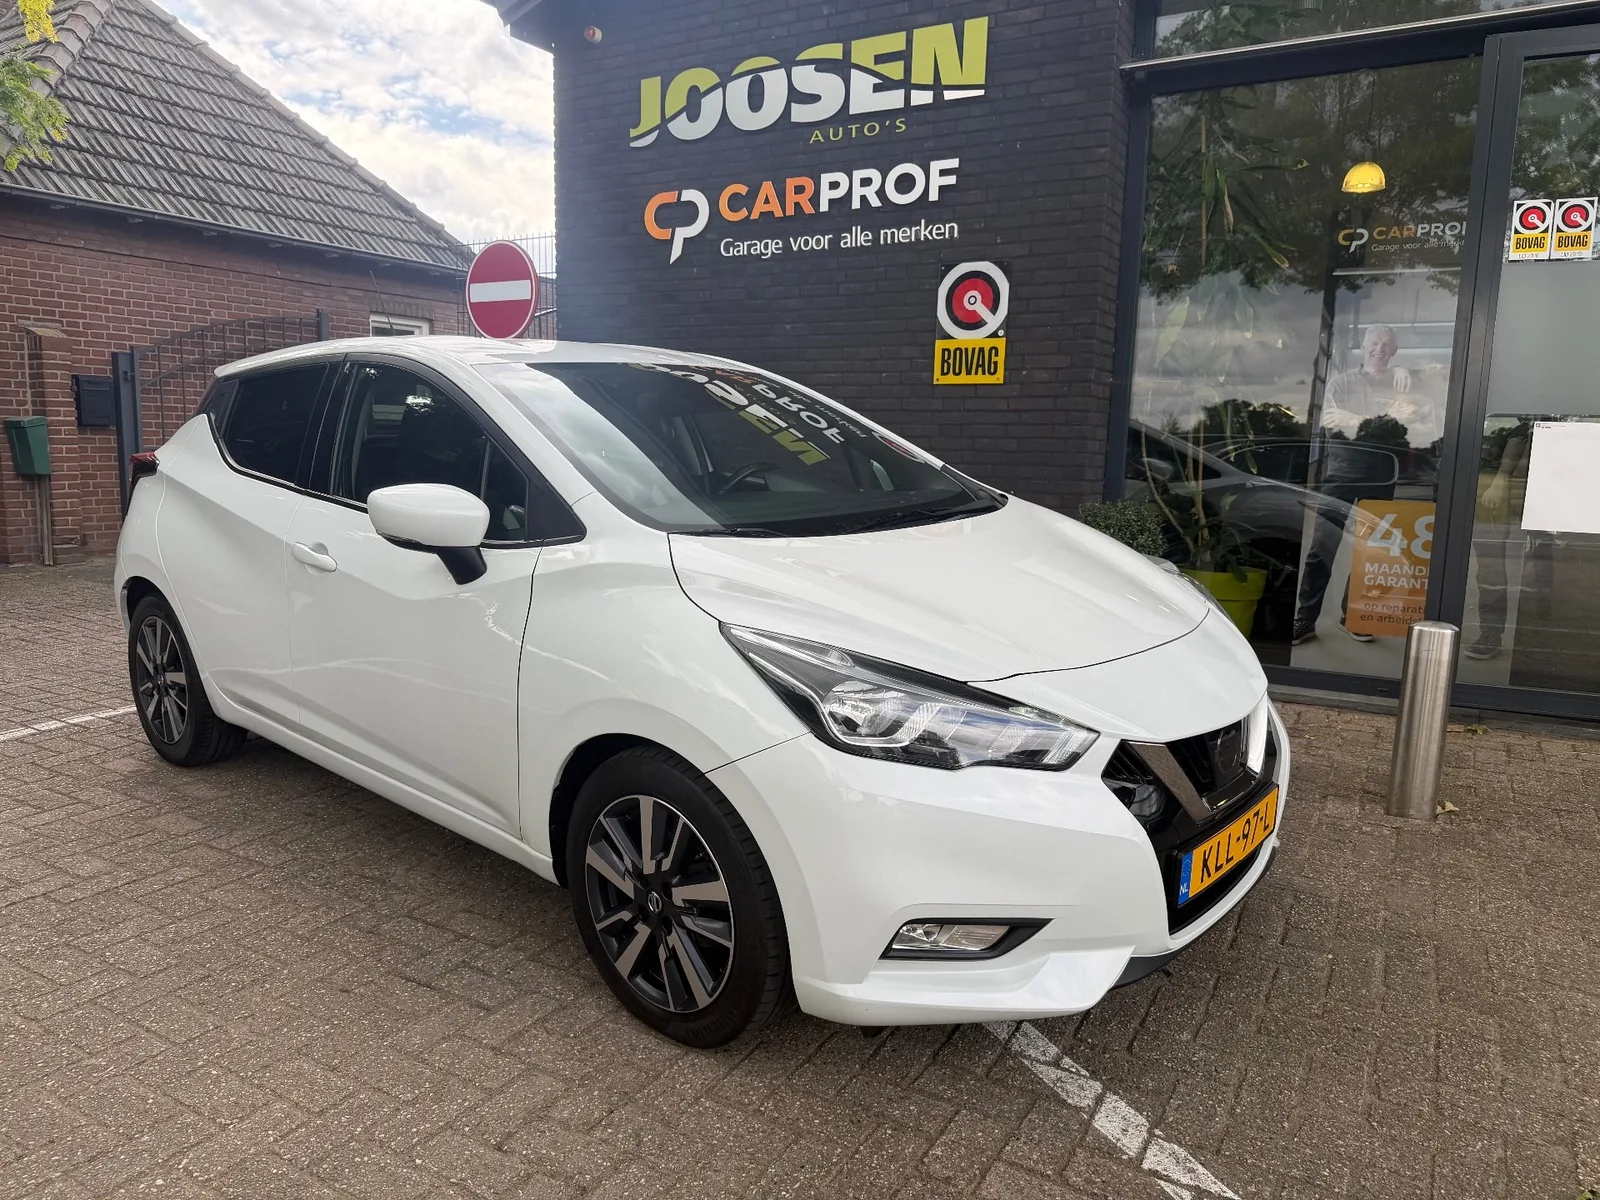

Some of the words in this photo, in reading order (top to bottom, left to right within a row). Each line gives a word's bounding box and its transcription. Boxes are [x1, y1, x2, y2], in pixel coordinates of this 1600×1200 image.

[629, 16, 989, 147] JOOSEN
[809, 118, 907, 144] AUTO'S
[718, 158, 960, 222] CARPROF
[720, 237, 783, 259] Garage
[790, 231, 833, 251] voor
[840, 226, 872, 248] alle
[880, 220, 959, 245] merken
[1515, 236, 1546, 250] BOVAG
[1557, 234, 1588, 248] BOVAG
[1371, 243, 1400, 252] Garage
[940, 346, 999, 377] BOVAG
[1365, 562, 1430, 576] MAAND
[1364, 602, 1378, 612] op
[1360, 614, 1373, 622] en
[1200, 801, 1270, 884] KLL-97-L
[1179, 881, 1189, 895] NL
